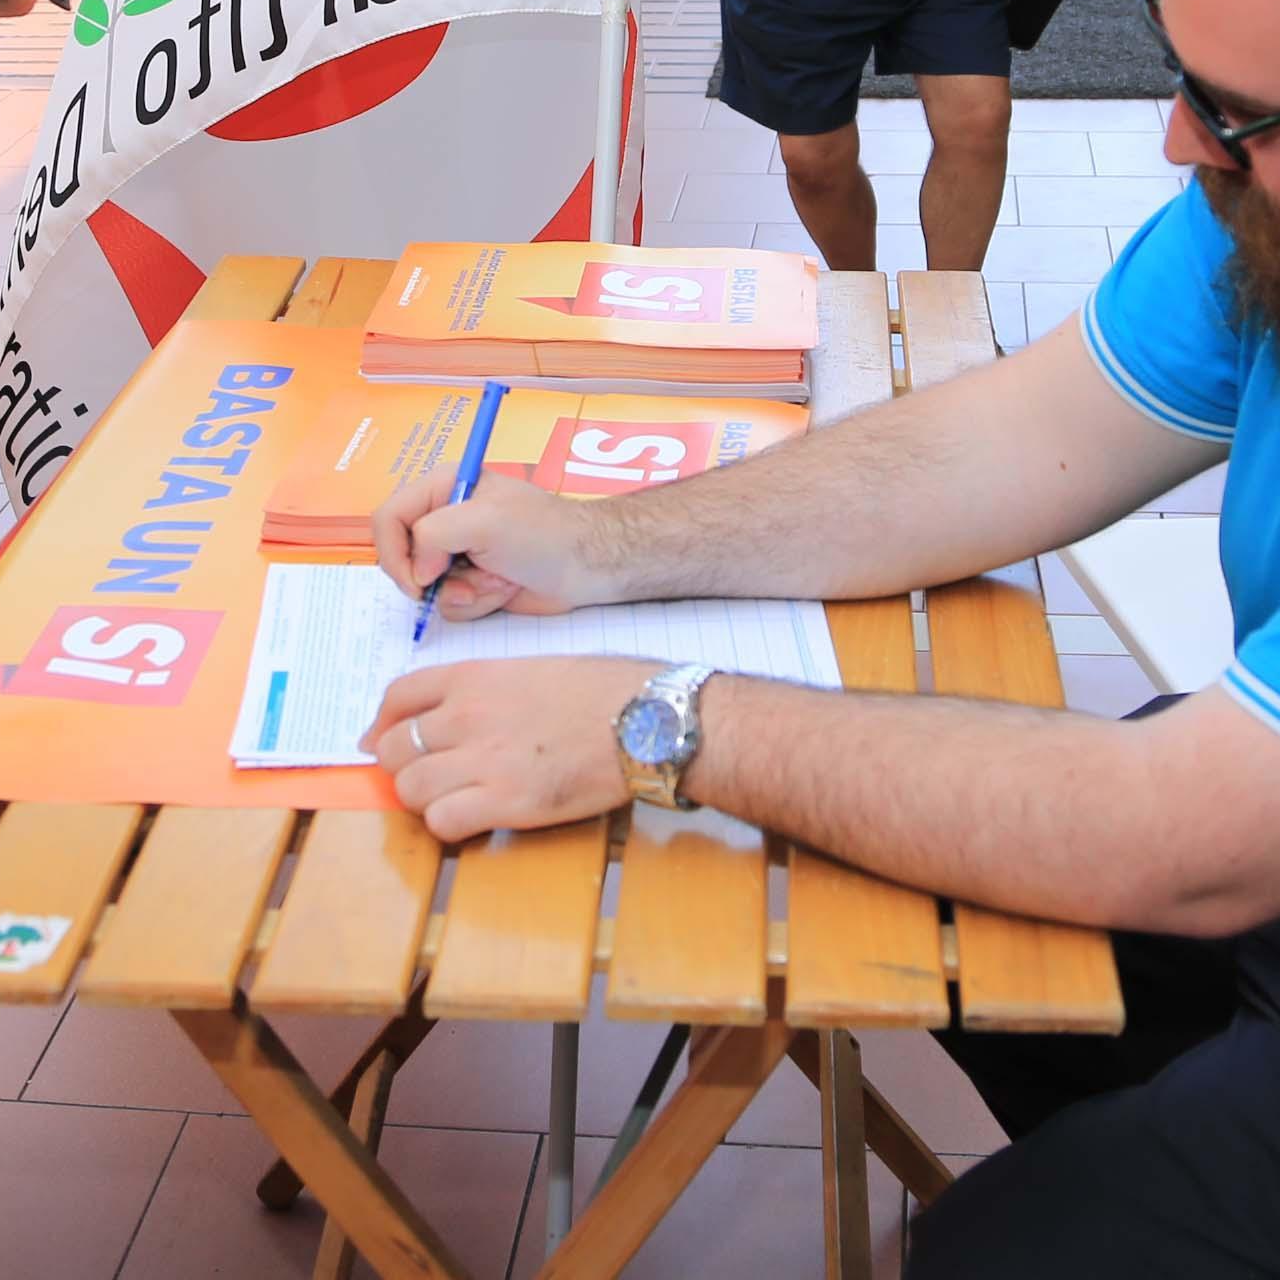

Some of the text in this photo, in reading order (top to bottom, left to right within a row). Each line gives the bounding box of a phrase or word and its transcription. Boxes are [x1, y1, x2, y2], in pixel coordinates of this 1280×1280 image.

[731, 268, 759, 304] BASTA
[728, 306, 755, 324] UN
[143, 364, 295, 510] BASTA
[92, 521, 215, 593] UN
